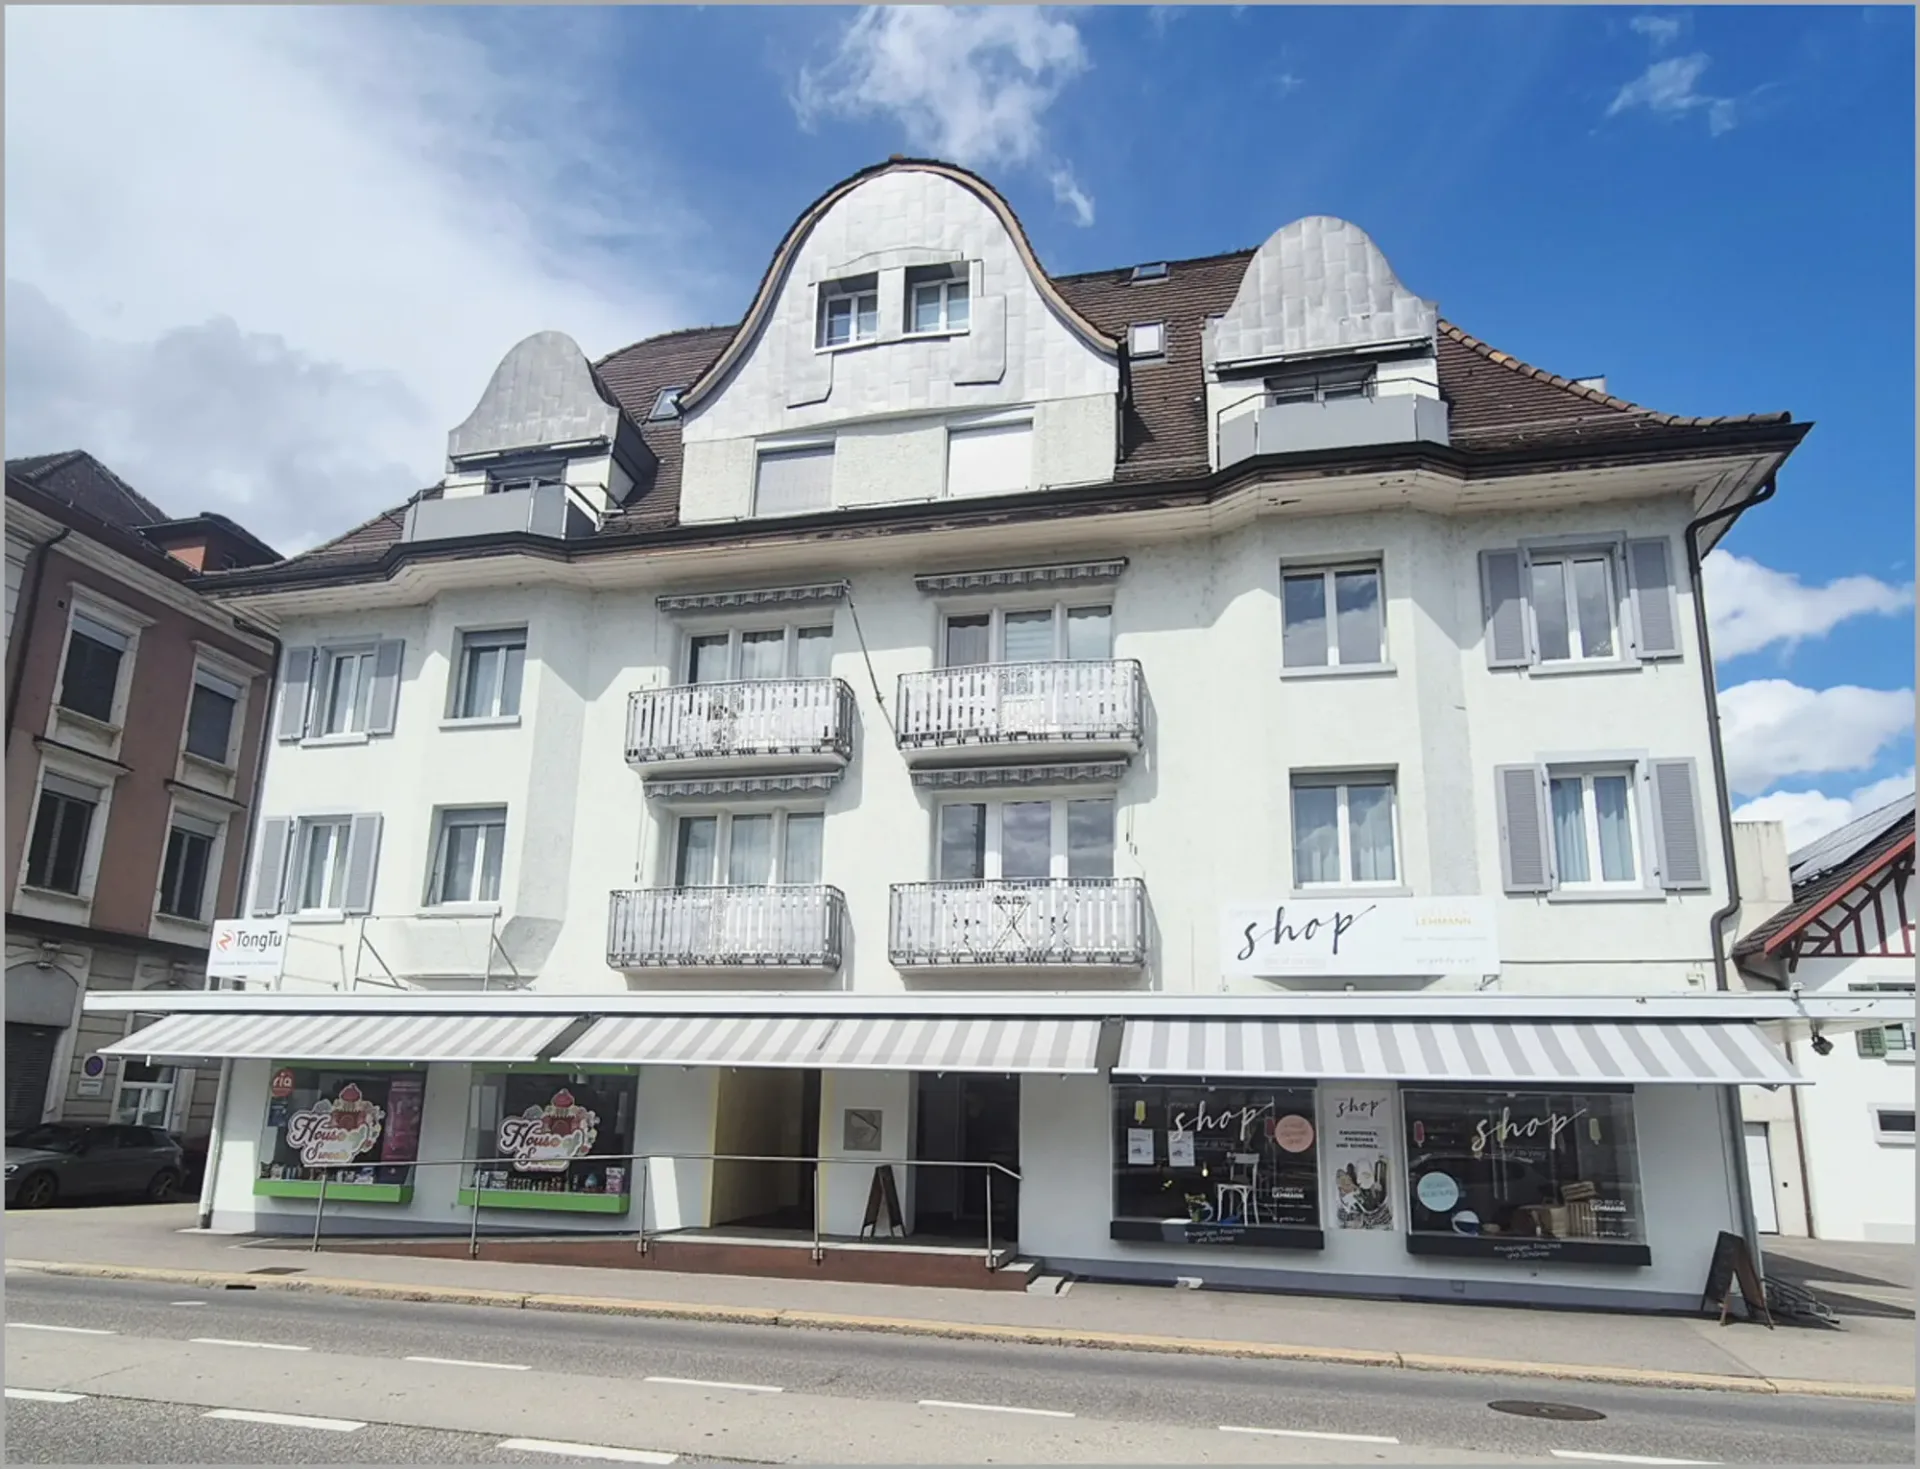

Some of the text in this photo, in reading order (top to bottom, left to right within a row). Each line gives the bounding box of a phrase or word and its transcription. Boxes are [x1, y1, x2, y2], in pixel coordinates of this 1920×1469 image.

[236, 930, 282, 952] TongTu
[1237, 904, 1377, 961] shop
[272, 1072, 293, 1088] ria
[1170, 1100, 1275, 1142] shop
[1335, 1097, 1388, 1118] shop
[292, 1115, 346, 1142] House
[502, 1121, 561, 1148] House
[1471, 1106, 1588, 1151] shop
